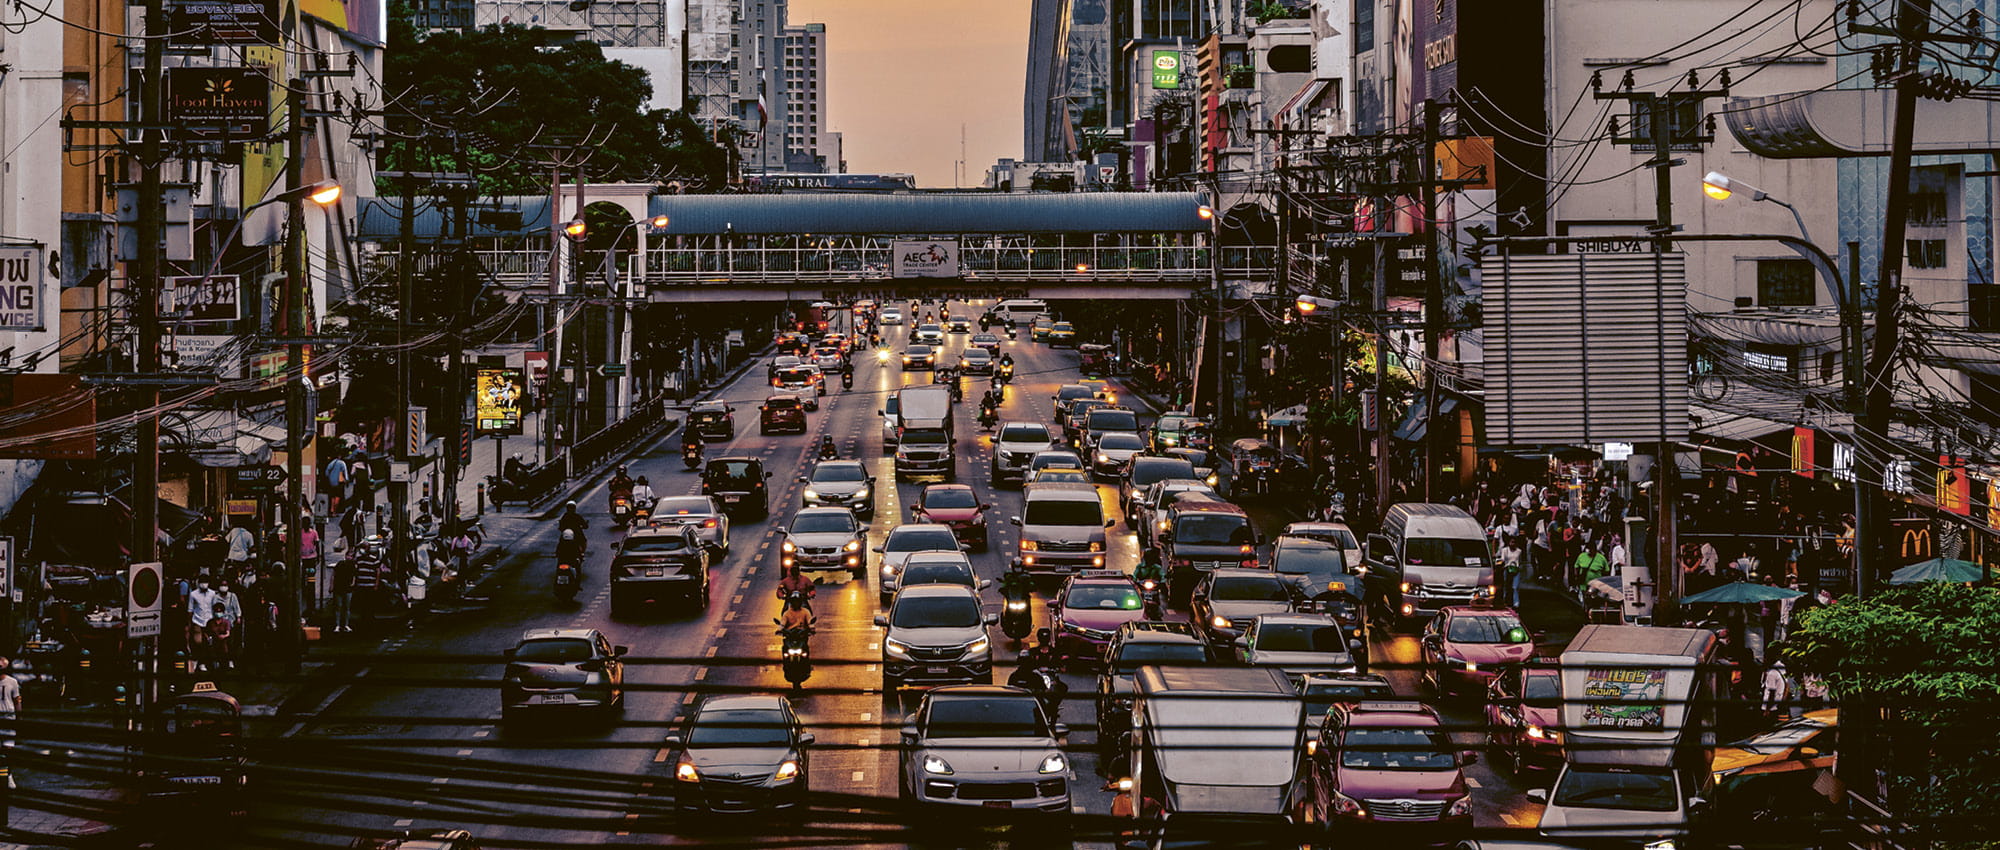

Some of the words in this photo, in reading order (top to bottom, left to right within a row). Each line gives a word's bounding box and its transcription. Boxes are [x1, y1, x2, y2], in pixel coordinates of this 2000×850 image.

[1577, 241, 1642, 253] SHIBUYA
[903, 252, 927, 263] AEC
[216, 281, 235, 304] 22
[266, 469, 280, 480] 22
